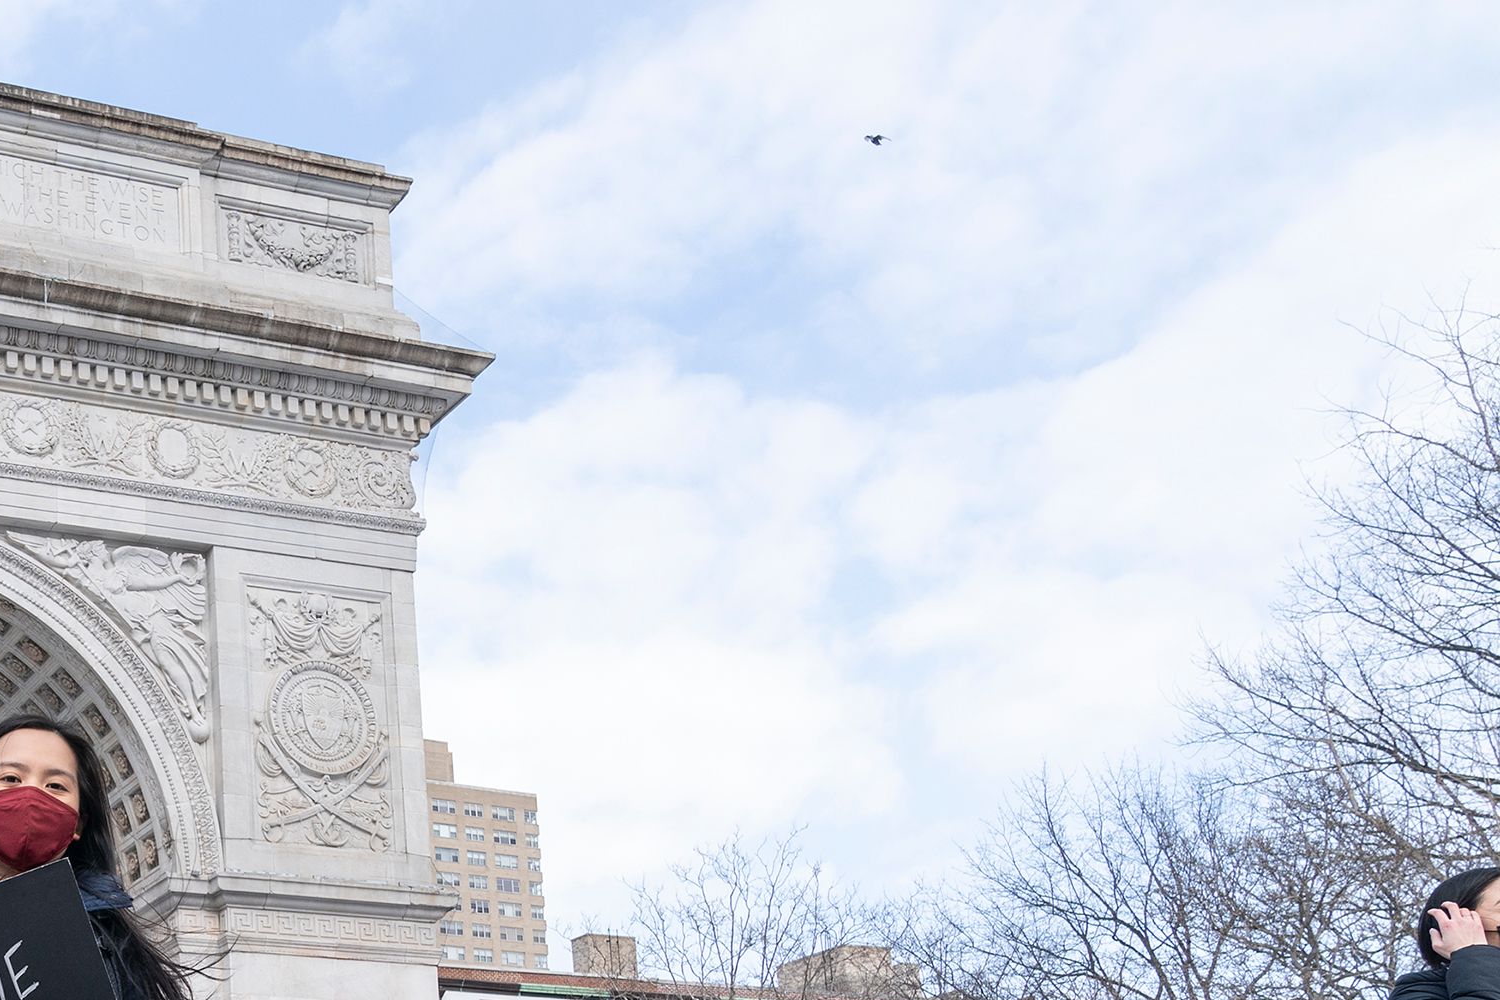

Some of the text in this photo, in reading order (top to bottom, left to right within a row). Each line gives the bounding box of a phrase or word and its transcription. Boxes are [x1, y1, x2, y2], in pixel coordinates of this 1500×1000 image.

[21, 183, 69, 208] THE
[85, 194, 165, 225] EVENT
[53, 169, 99, 193] THE
[109, 180, 164, 206] WISE
[0, 194, 166, 242] WASHINGTON
